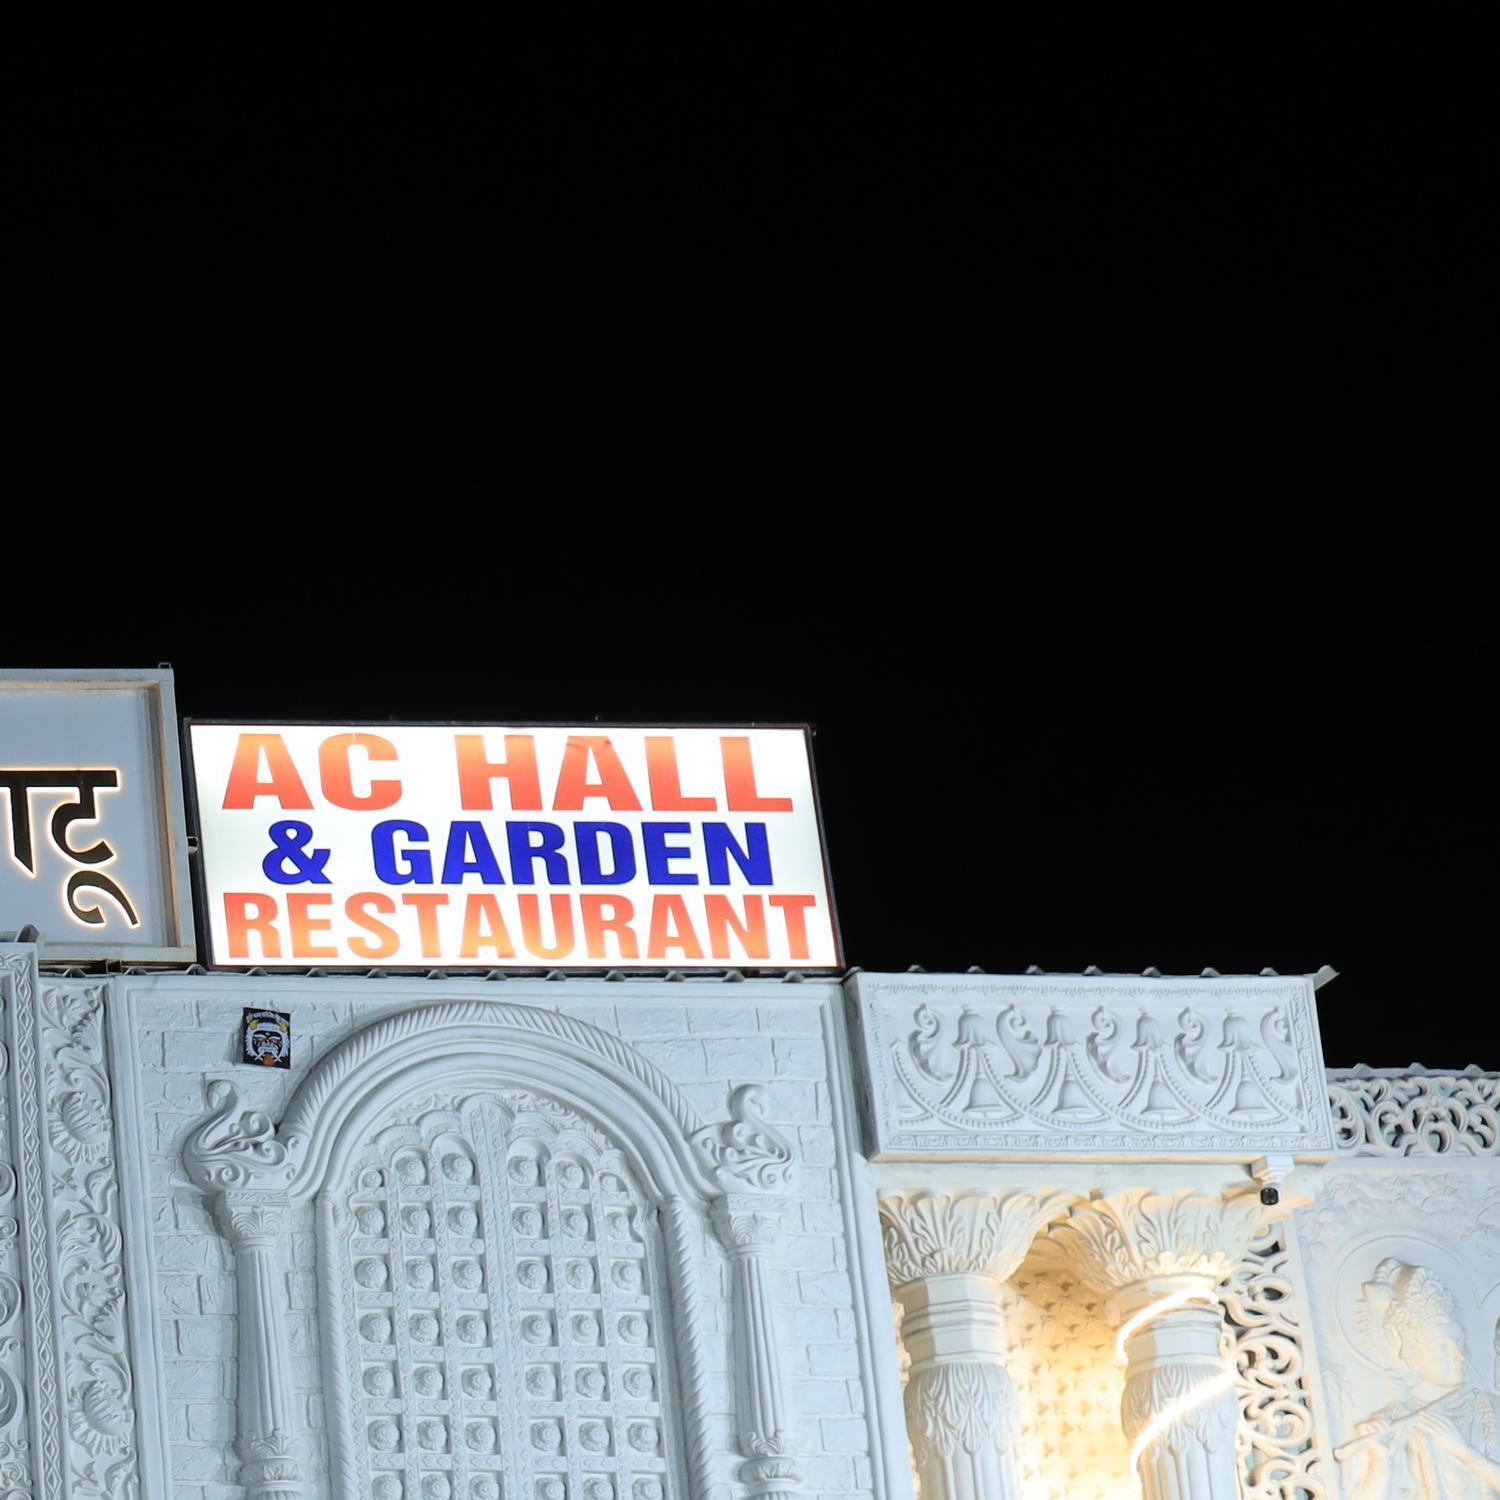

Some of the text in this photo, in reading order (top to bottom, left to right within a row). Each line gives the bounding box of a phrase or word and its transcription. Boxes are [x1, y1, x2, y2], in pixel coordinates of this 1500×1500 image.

[222, 733, 794, 813] AC HALL
[262, 819, 774, 887] & GARDEN
[222, 892, 816, 960] RESTAURANT
